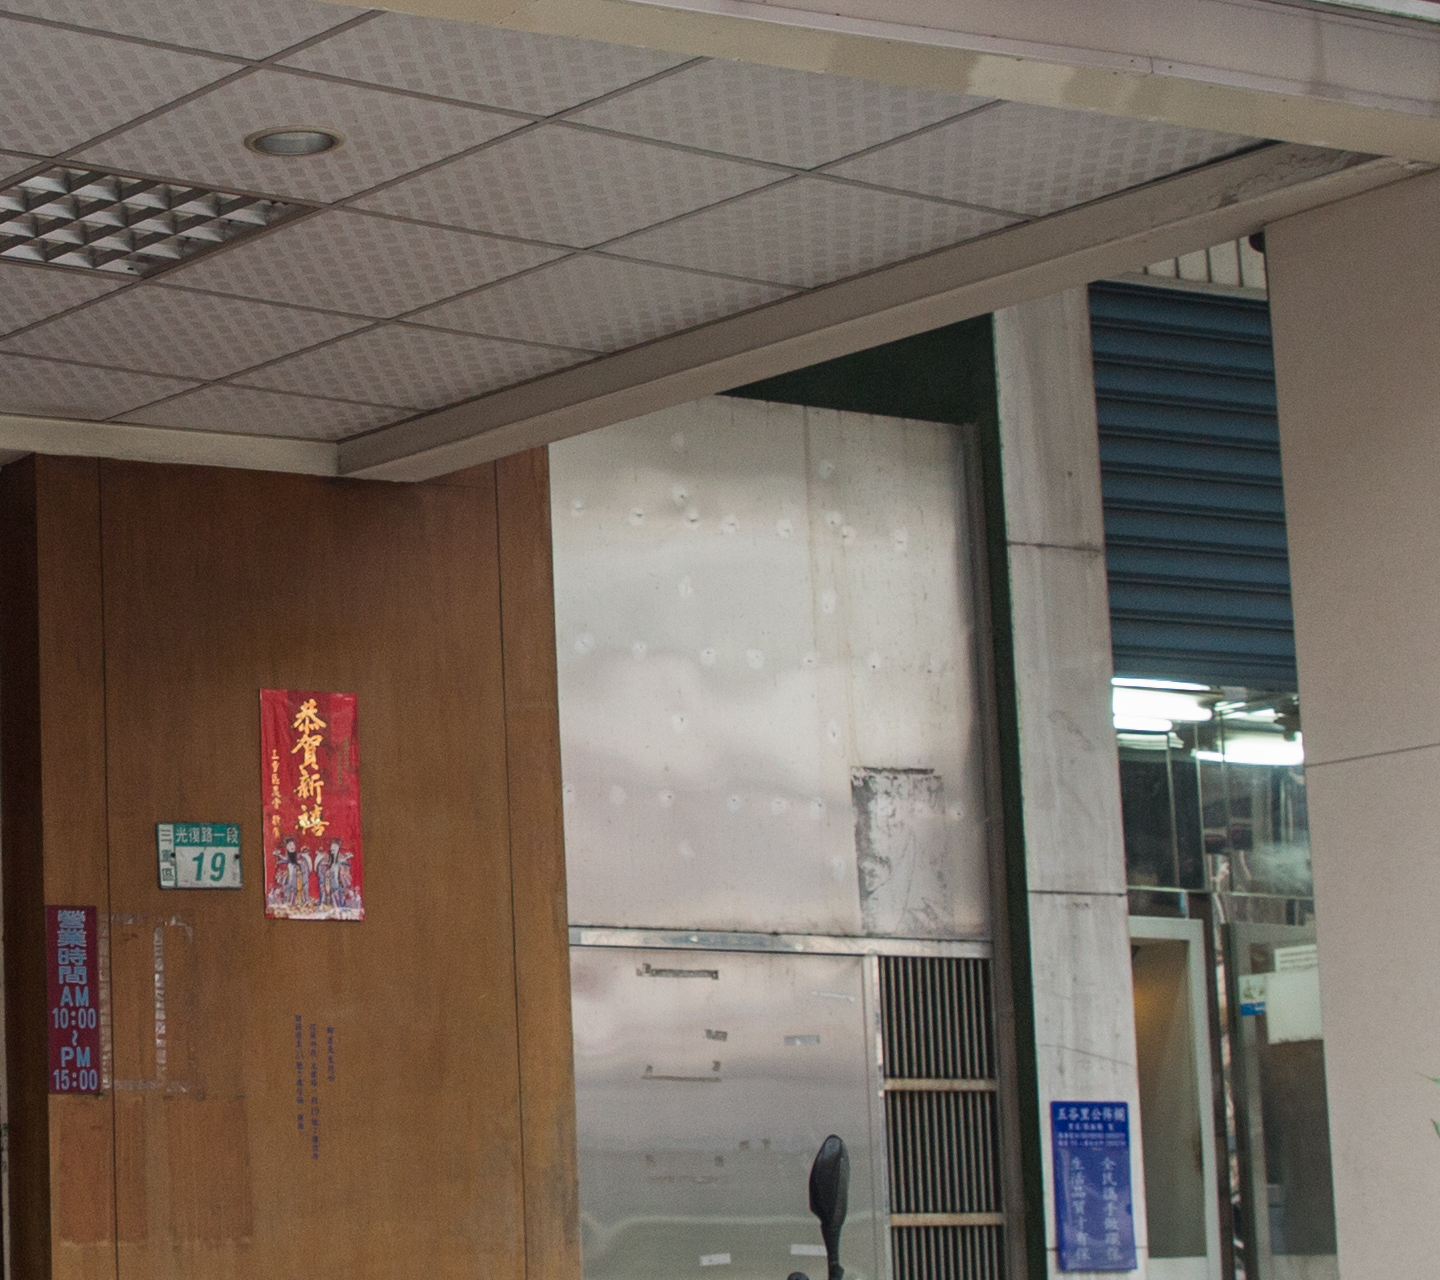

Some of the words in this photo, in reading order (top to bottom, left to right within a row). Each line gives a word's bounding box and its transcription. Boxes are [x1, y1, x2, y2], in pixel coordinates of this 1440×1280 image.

[290, 698, 330, 837] 恭賀新禧
[176, 826, 239, 845] 光復路一段
[192, 851, 226, 882] 19
[57, 910, 87, 985] 營業時間
[60, 986, 90, 1007] AM
[52, 1008, 97, 1029] 10:00
[60, 1047, 91, 1067] PM
[53, 1069, 98, 1091] 15:00
